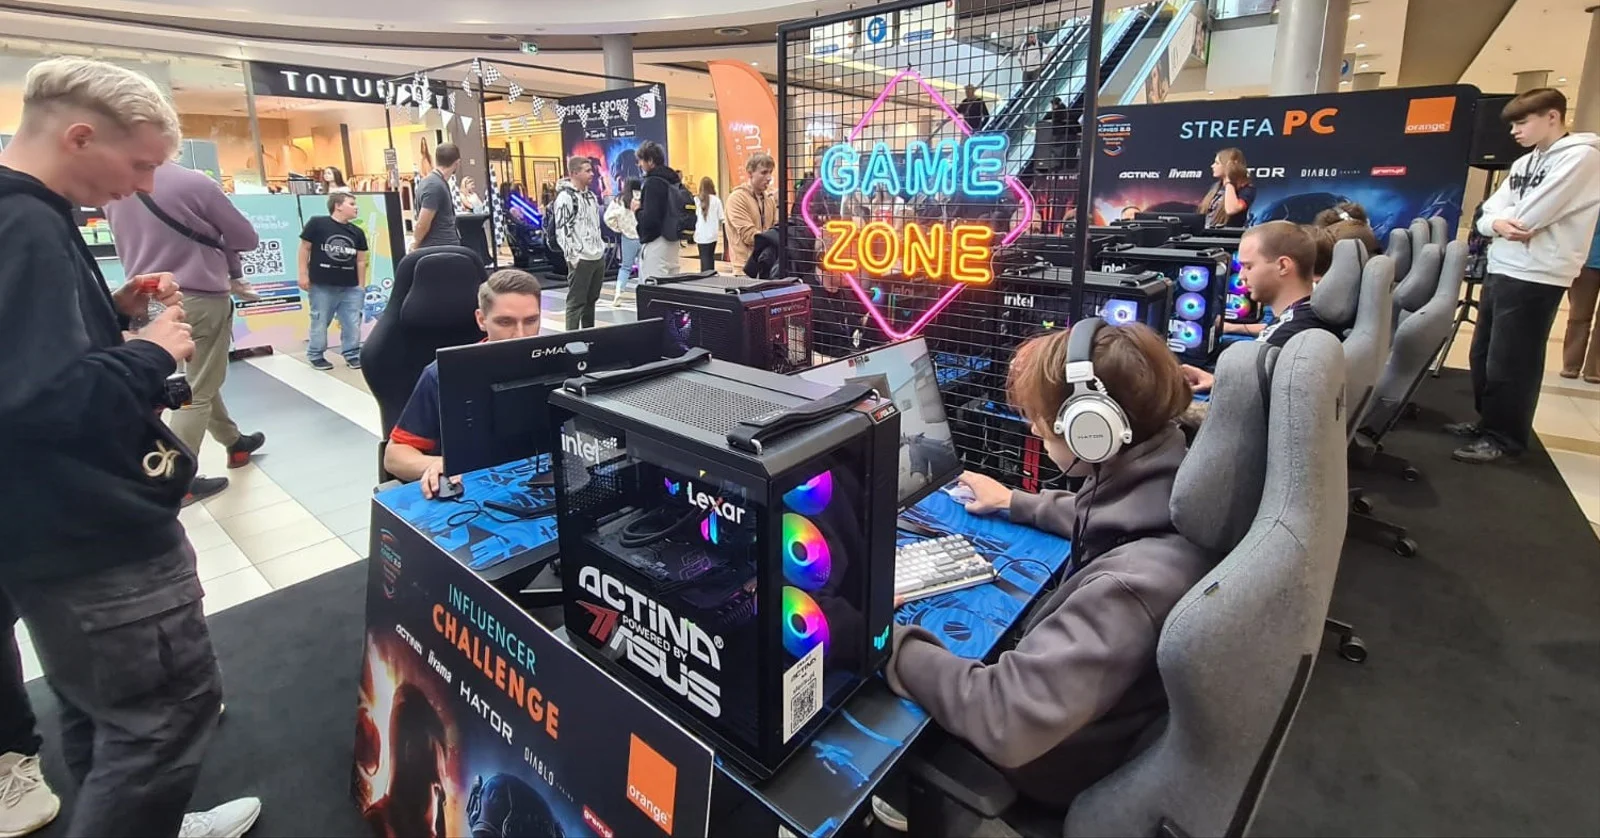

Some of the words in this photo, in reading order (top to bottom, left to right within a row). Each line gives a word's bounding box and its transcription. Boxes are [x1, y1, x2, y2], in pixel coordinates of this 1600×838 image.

[1179, 118, 1275, 139] STREFA
[1283, 107, 1339, 136] PC
[1406, 122, 1449, 132] orange
[820, 134, 1006, 196] GAME
[1247, 167, 1286, 178] TOR
[1301, 168, 1338, 178] DIABLO
[823, 220, 992, 283] ZONE
[1003, 294, 1035, 308] intel
[560, 427, 601, 465] intel
[686, 481, 746, 524] Lexar
[448, 584, 537, 675] INFLUENCER
[622, 614, 671, 652] POWERED
[673, 646, 688, 662] BY
[432, 603, 560, 740] CHALLENGE
[610, 625, 722, 718] ASUS
[459, 680, 513, 745] HATOR
[524, 746, 554, 787] DIABLO
[629, 784, 672, 826] orange
